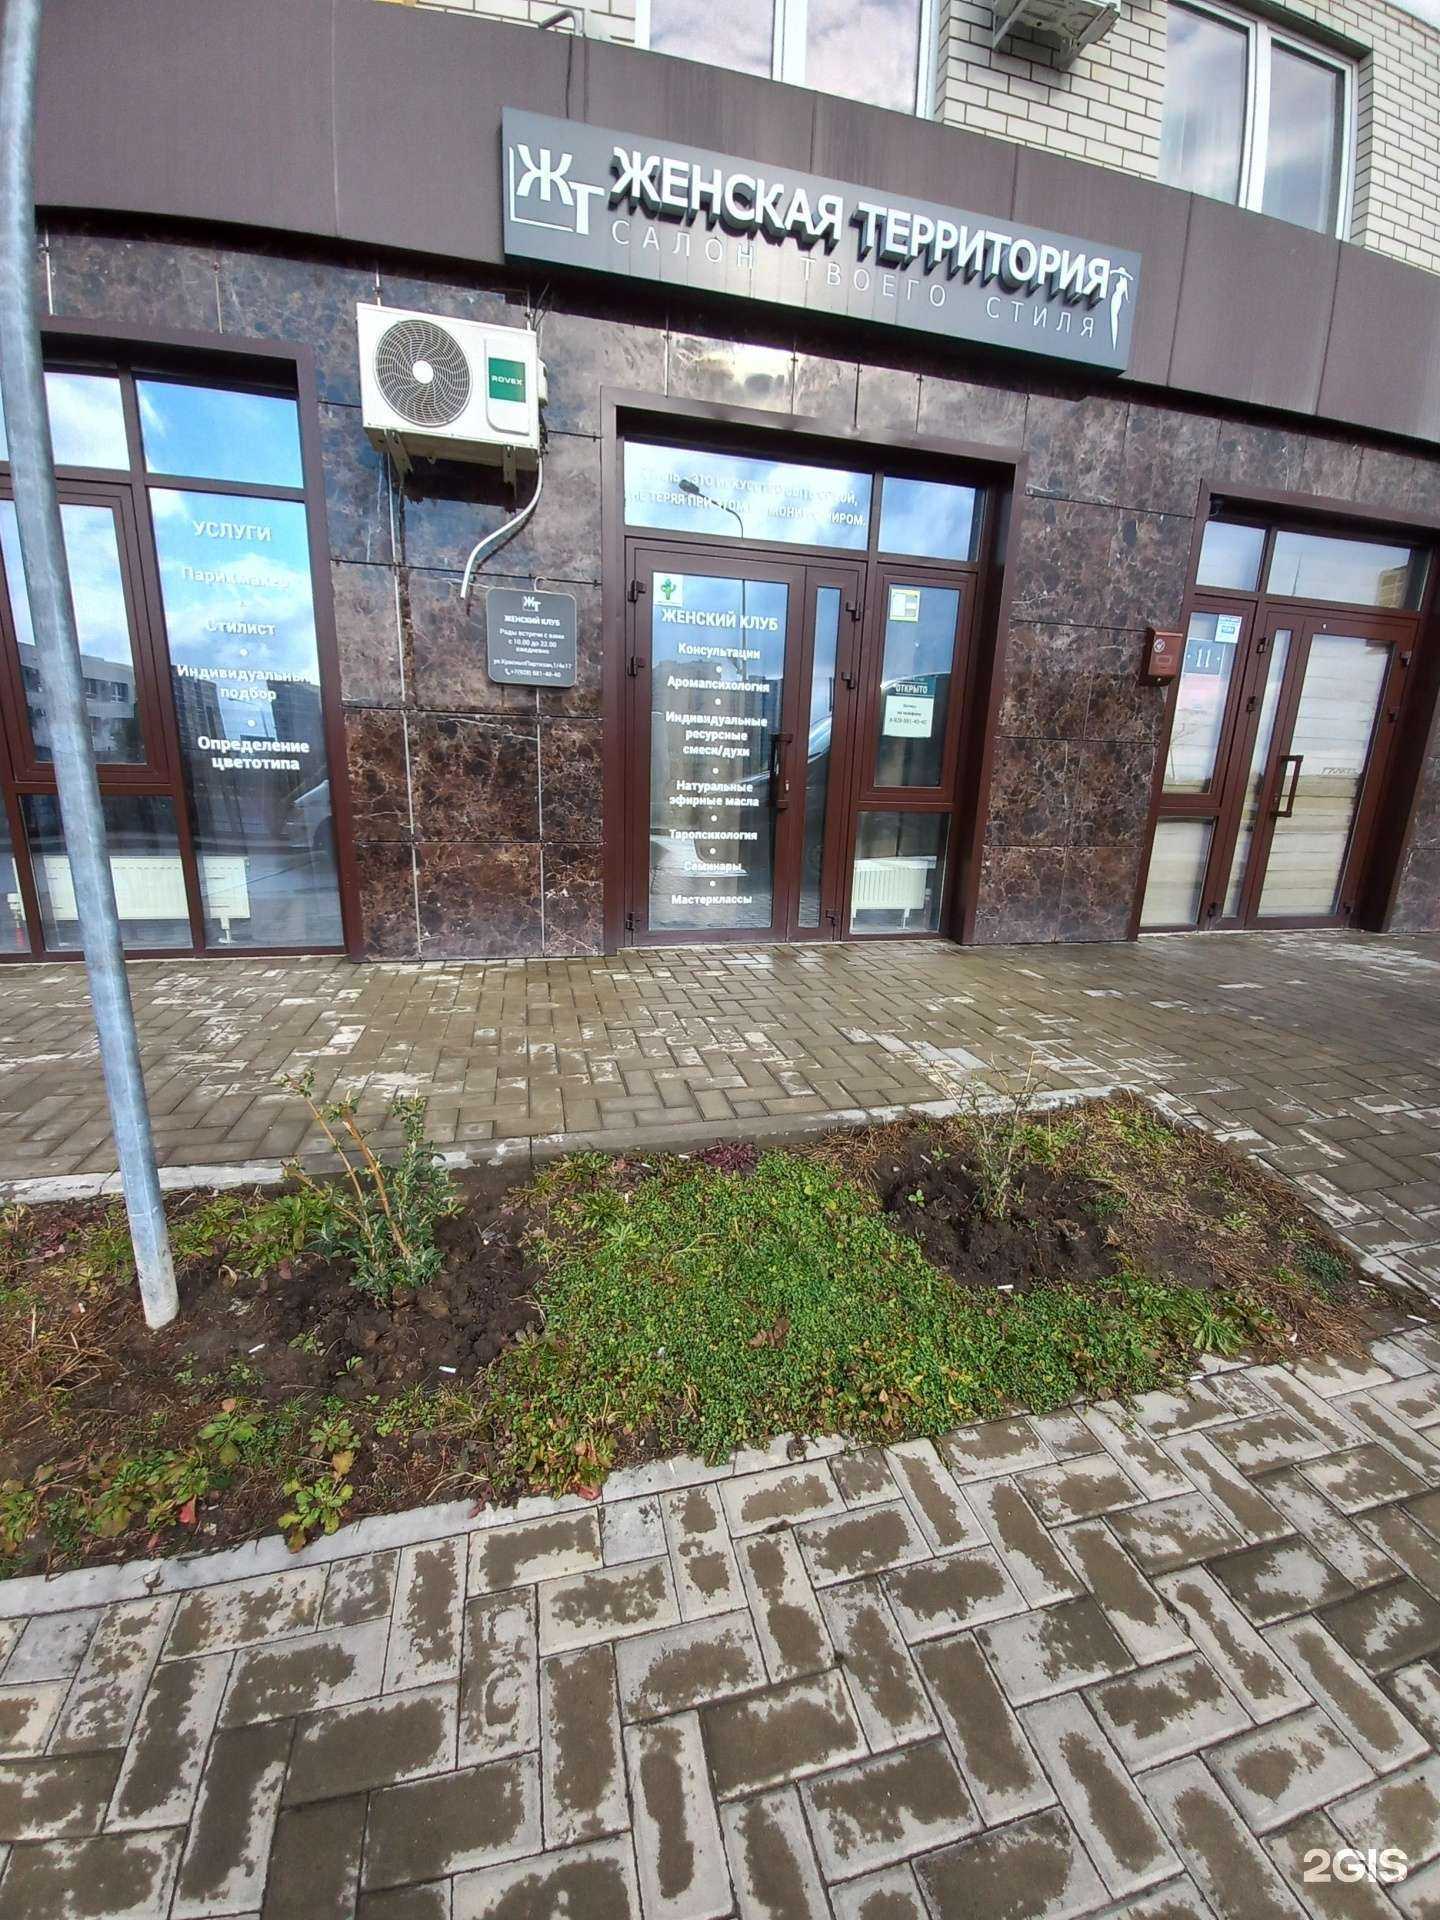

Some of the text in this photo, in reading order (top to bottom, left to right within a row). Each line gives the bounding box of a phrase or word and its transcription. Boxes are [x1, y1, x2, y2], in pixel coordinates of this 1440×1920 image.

[611, 146, 1111, 301] ЖЕНСКАЯ ТЕРРИТОРИЯ
[612, 219, 1094, 339] САЛОН ТВОЕГО СТИЛЯ
[491, 375, 523, 386] ROVEX
[193, 521, 272, 542] УСЛУГИ
[662, 608, 778, 631] ЖЕНСКИЙ КЛУБ
[206, 619, 276, 636] Стилист
[678, 642, 761, 660] Консультации
[667, 675, 770, 694] Аромапсихология
[895, 684, 929, 695] ОТКРЫТО
[220, 685, 277, 702] подбор
[665, 711, 768, 727] Индивидуальные
[685, 730, 748, 742] ресурсные
[198, 736, 310, 754] Определение
[683, 745, 750, 758] смеси/духи
[212, 756, 300, 771] цветотипа
[676, 780, 754, 793] Натуральные
[669, 794, 760, 807] эфирные масла
[669, 829, 758, 841] Таропсихология
[684, 861, 742, 872] Семинары
[671, 894, 753, 906] Мастерклассы
